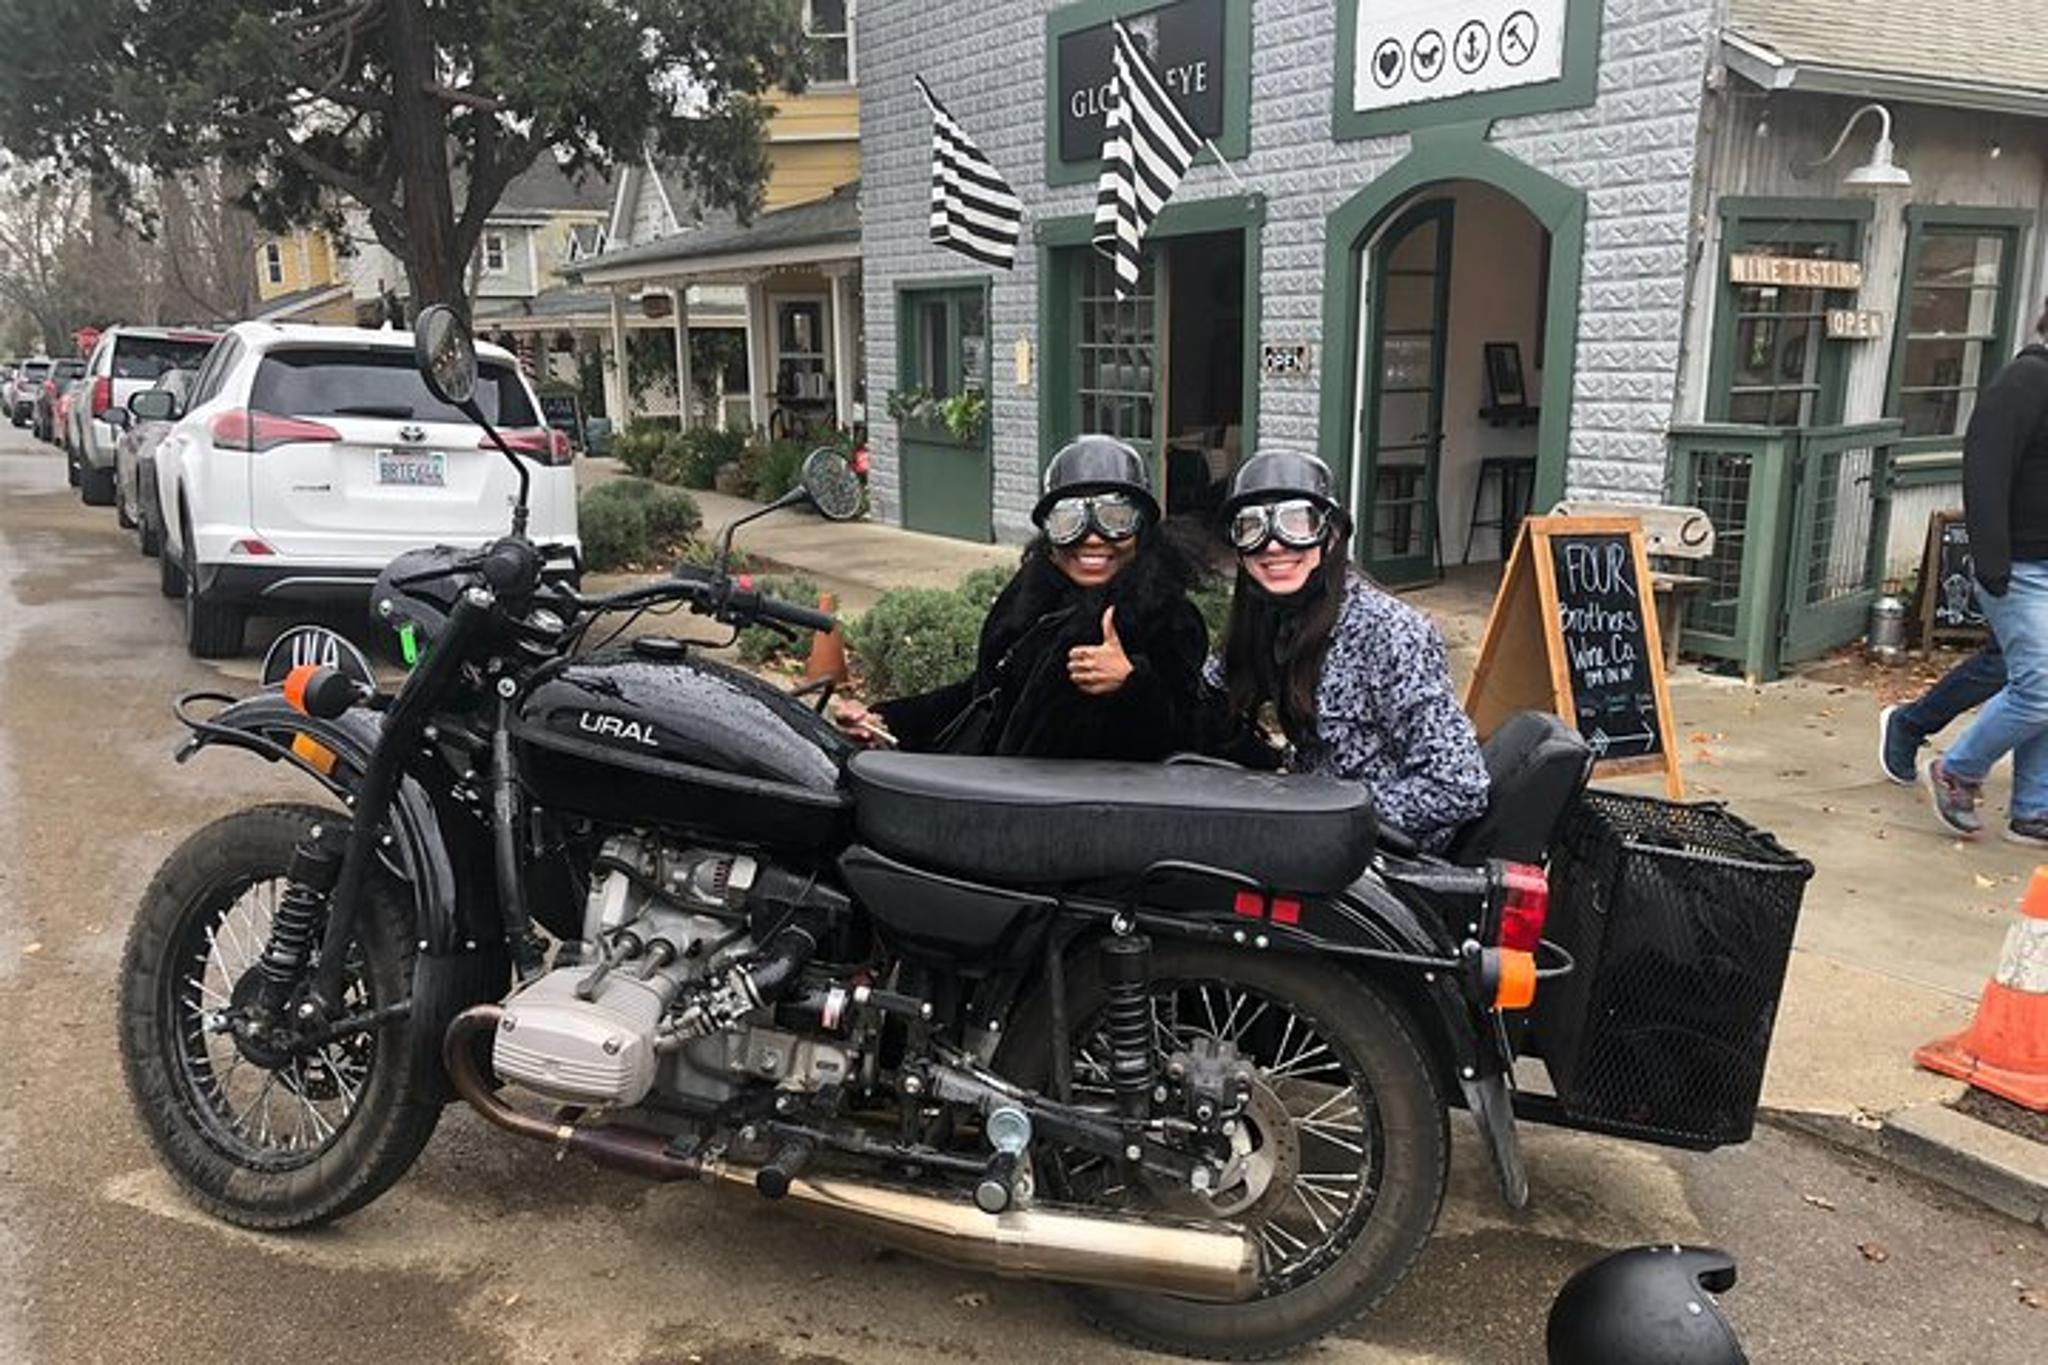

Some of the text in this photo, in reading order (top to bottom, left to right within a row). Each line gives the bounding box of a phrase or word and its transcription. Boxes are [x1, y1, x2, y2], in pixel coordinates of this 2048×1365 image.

[1787, 259, 1863, 288] TASTING
[1833, 312, 1881, 336] OPEN
[1566, 542, 1637, 598] FOUR
[579, 710, 659, 746] URAL
